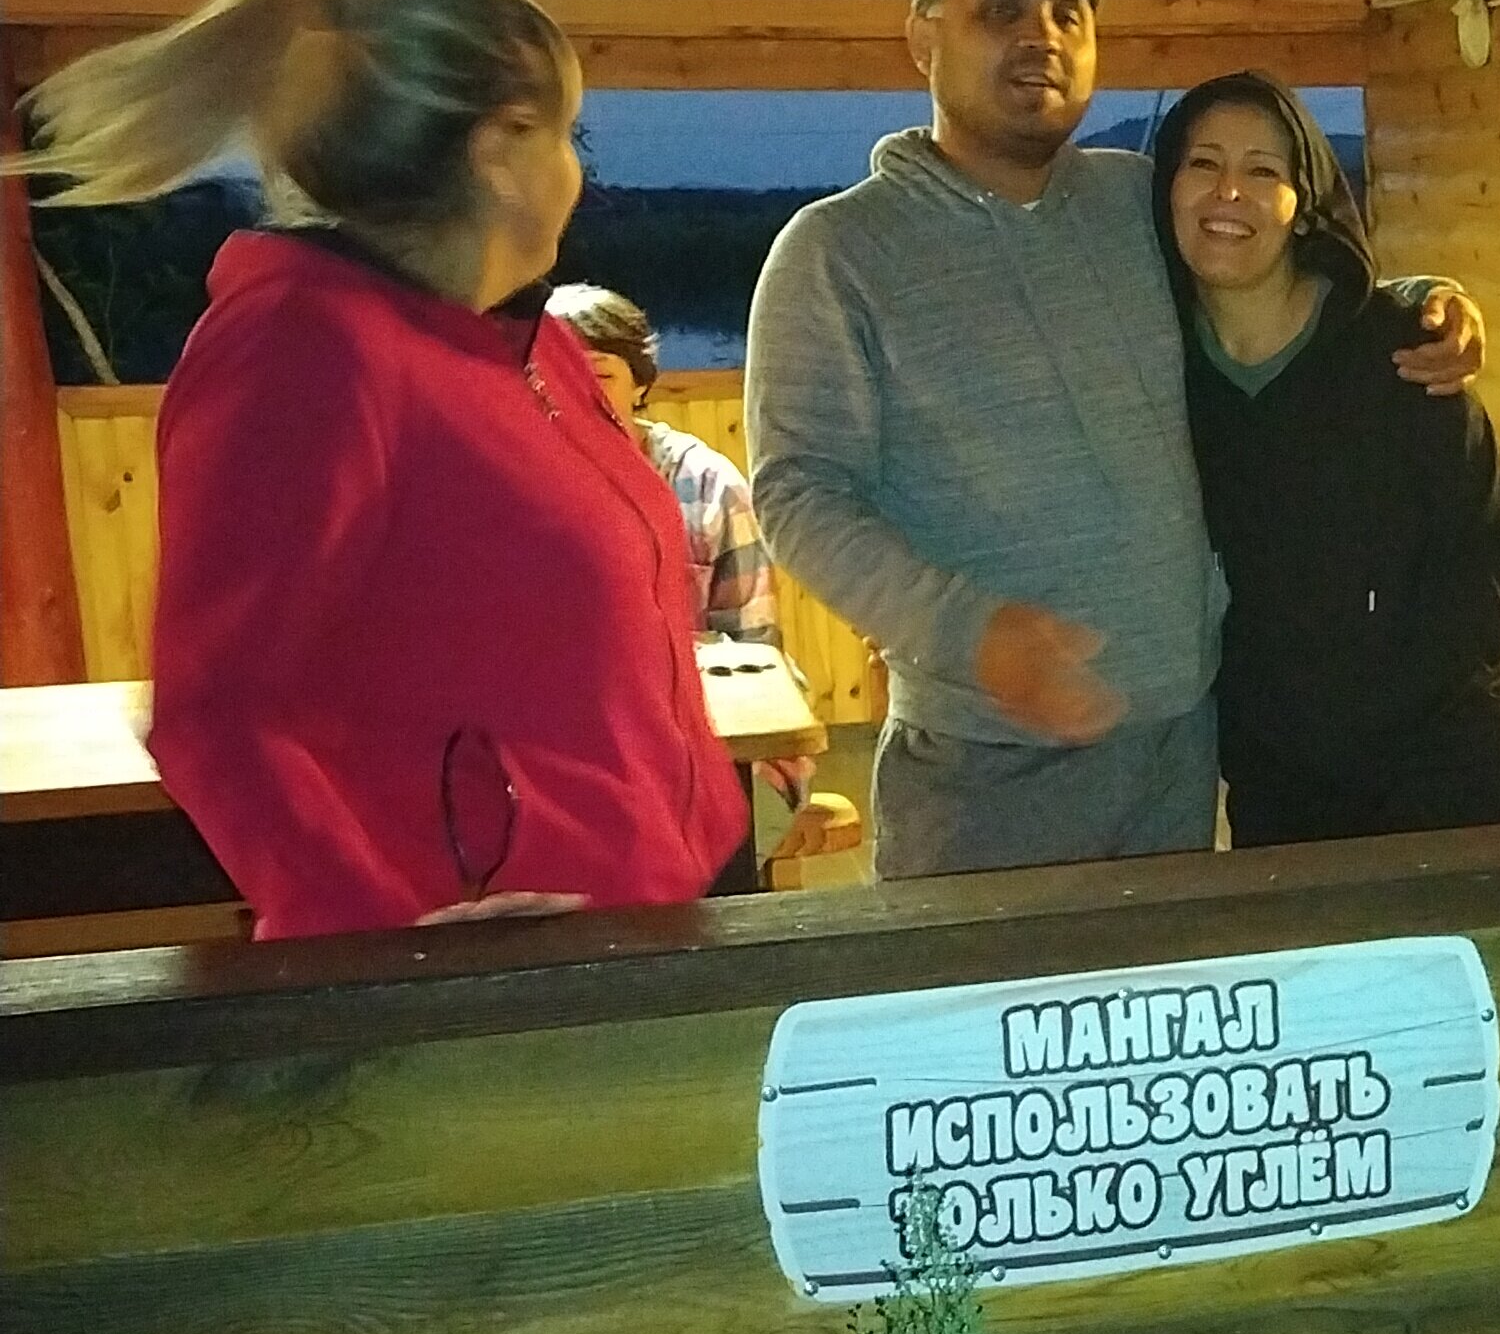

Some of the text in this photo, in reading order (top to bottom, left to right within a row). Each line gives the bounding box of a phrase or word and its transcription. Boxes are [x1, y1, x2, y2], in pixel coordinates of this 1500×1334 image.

[1003, 979, 1280, 1078] МАНГАЛ
[887, 1052, 1391, 1175] ИСПОЛЬЗОВАТЬ
[1177, 1123, 1391, 1221] УГЛЁМ
